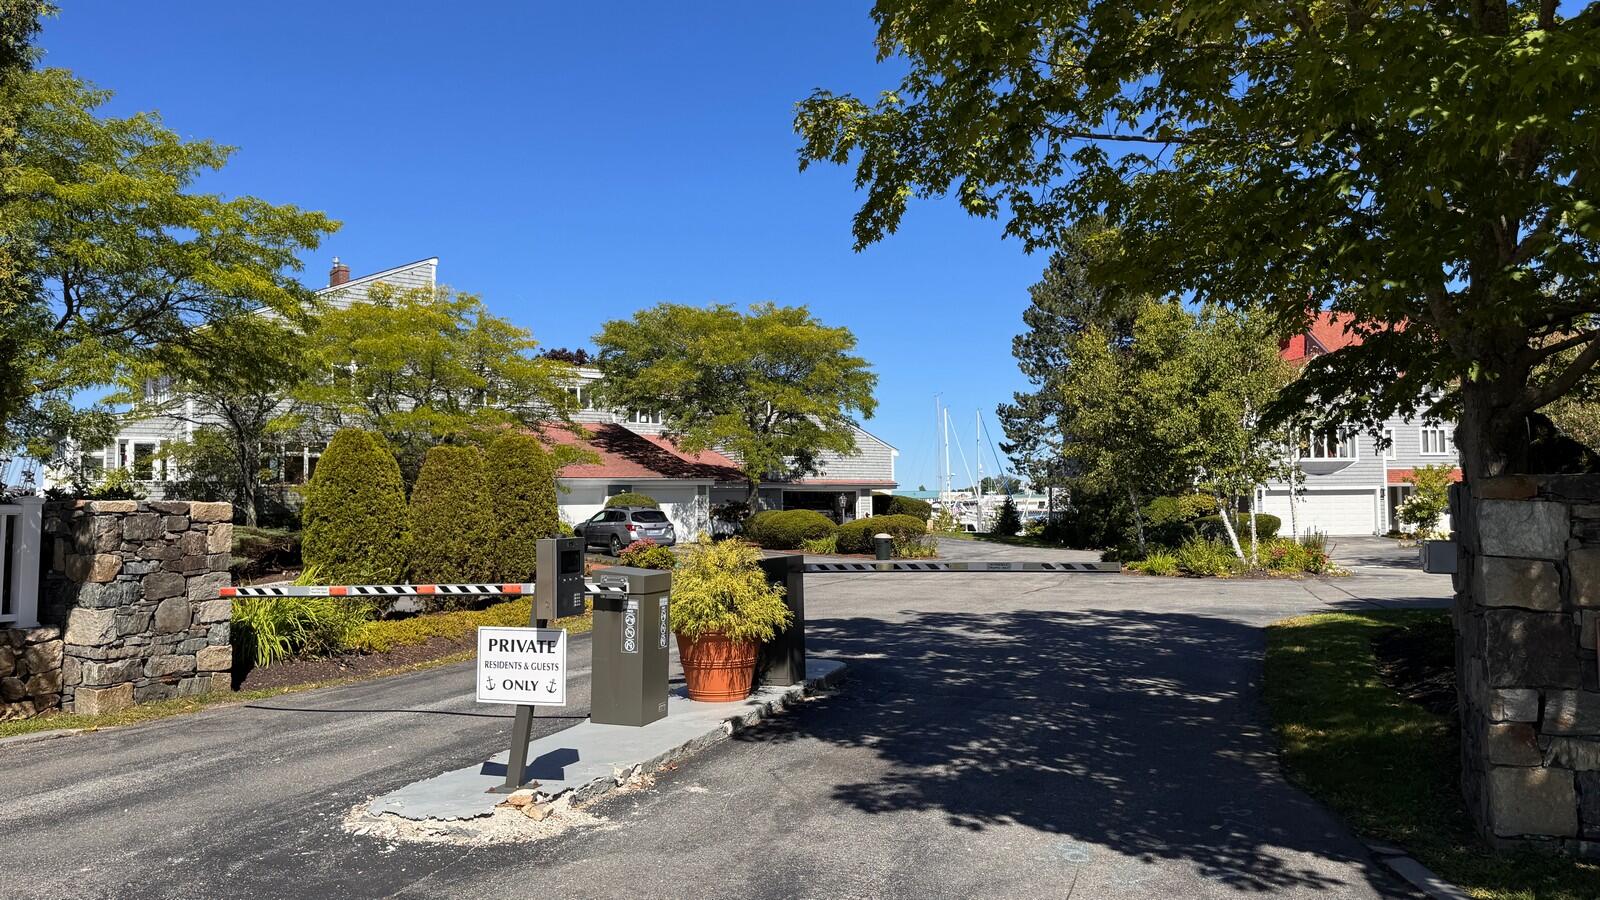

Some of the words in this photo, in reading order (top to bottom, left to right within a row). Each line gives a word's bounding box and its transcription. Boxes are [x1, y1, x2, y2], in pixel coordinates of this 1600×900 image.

[488, 638, 556, 654] PRIVATE
[484, 660, 522, 670] RESIDENTS
[523, 662, 529, 670] &
[530, 662, 559, 671] GUESTS
[502, 679, 539, 691] ONLY
